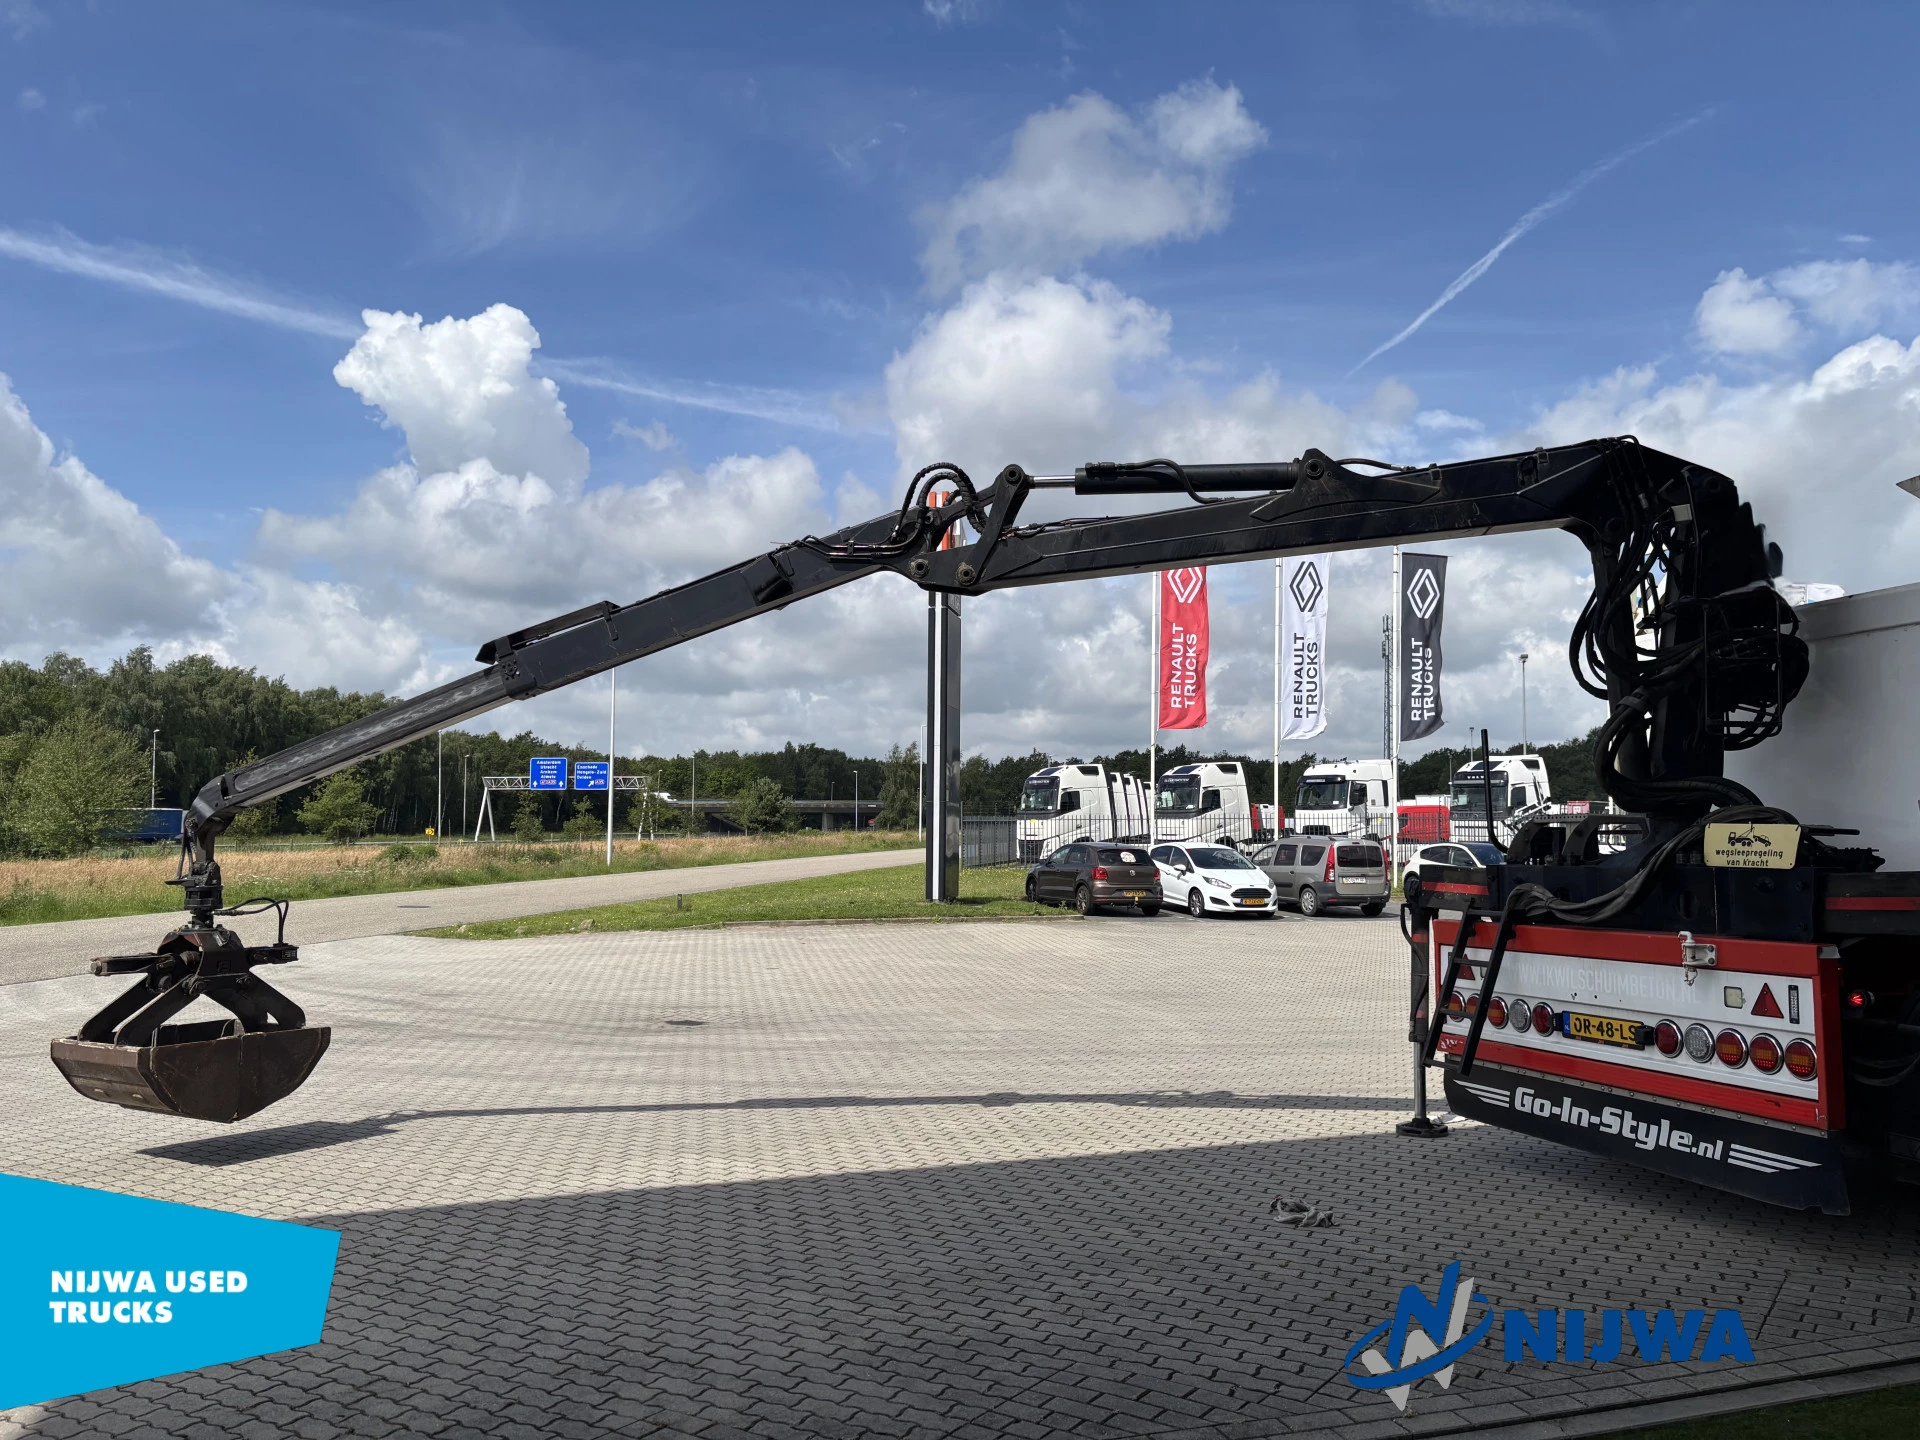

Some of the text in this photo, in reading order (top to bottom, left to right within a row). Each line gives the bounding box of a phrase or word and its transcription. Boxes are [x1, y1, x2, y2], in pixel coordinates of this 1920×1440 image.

[1171, 622, 1184, 709] RENAULT
[1184, 633, 1197, 709] TRUCKS
[1293, 632, 1305, 719] RENAULT
[1306, 641, 1318, 719] TRUCKS
[1411, 637, 1423, 721] RENAULT
[1424, 647, 1436, 720] TRUCKS
[1715, 848, 1783, 860] wegsleepregeling
[1573, 1017, 1636, 1041] OR-48-LS
[1514, 1086, 1724, 1161] Go-In-Style.nl
